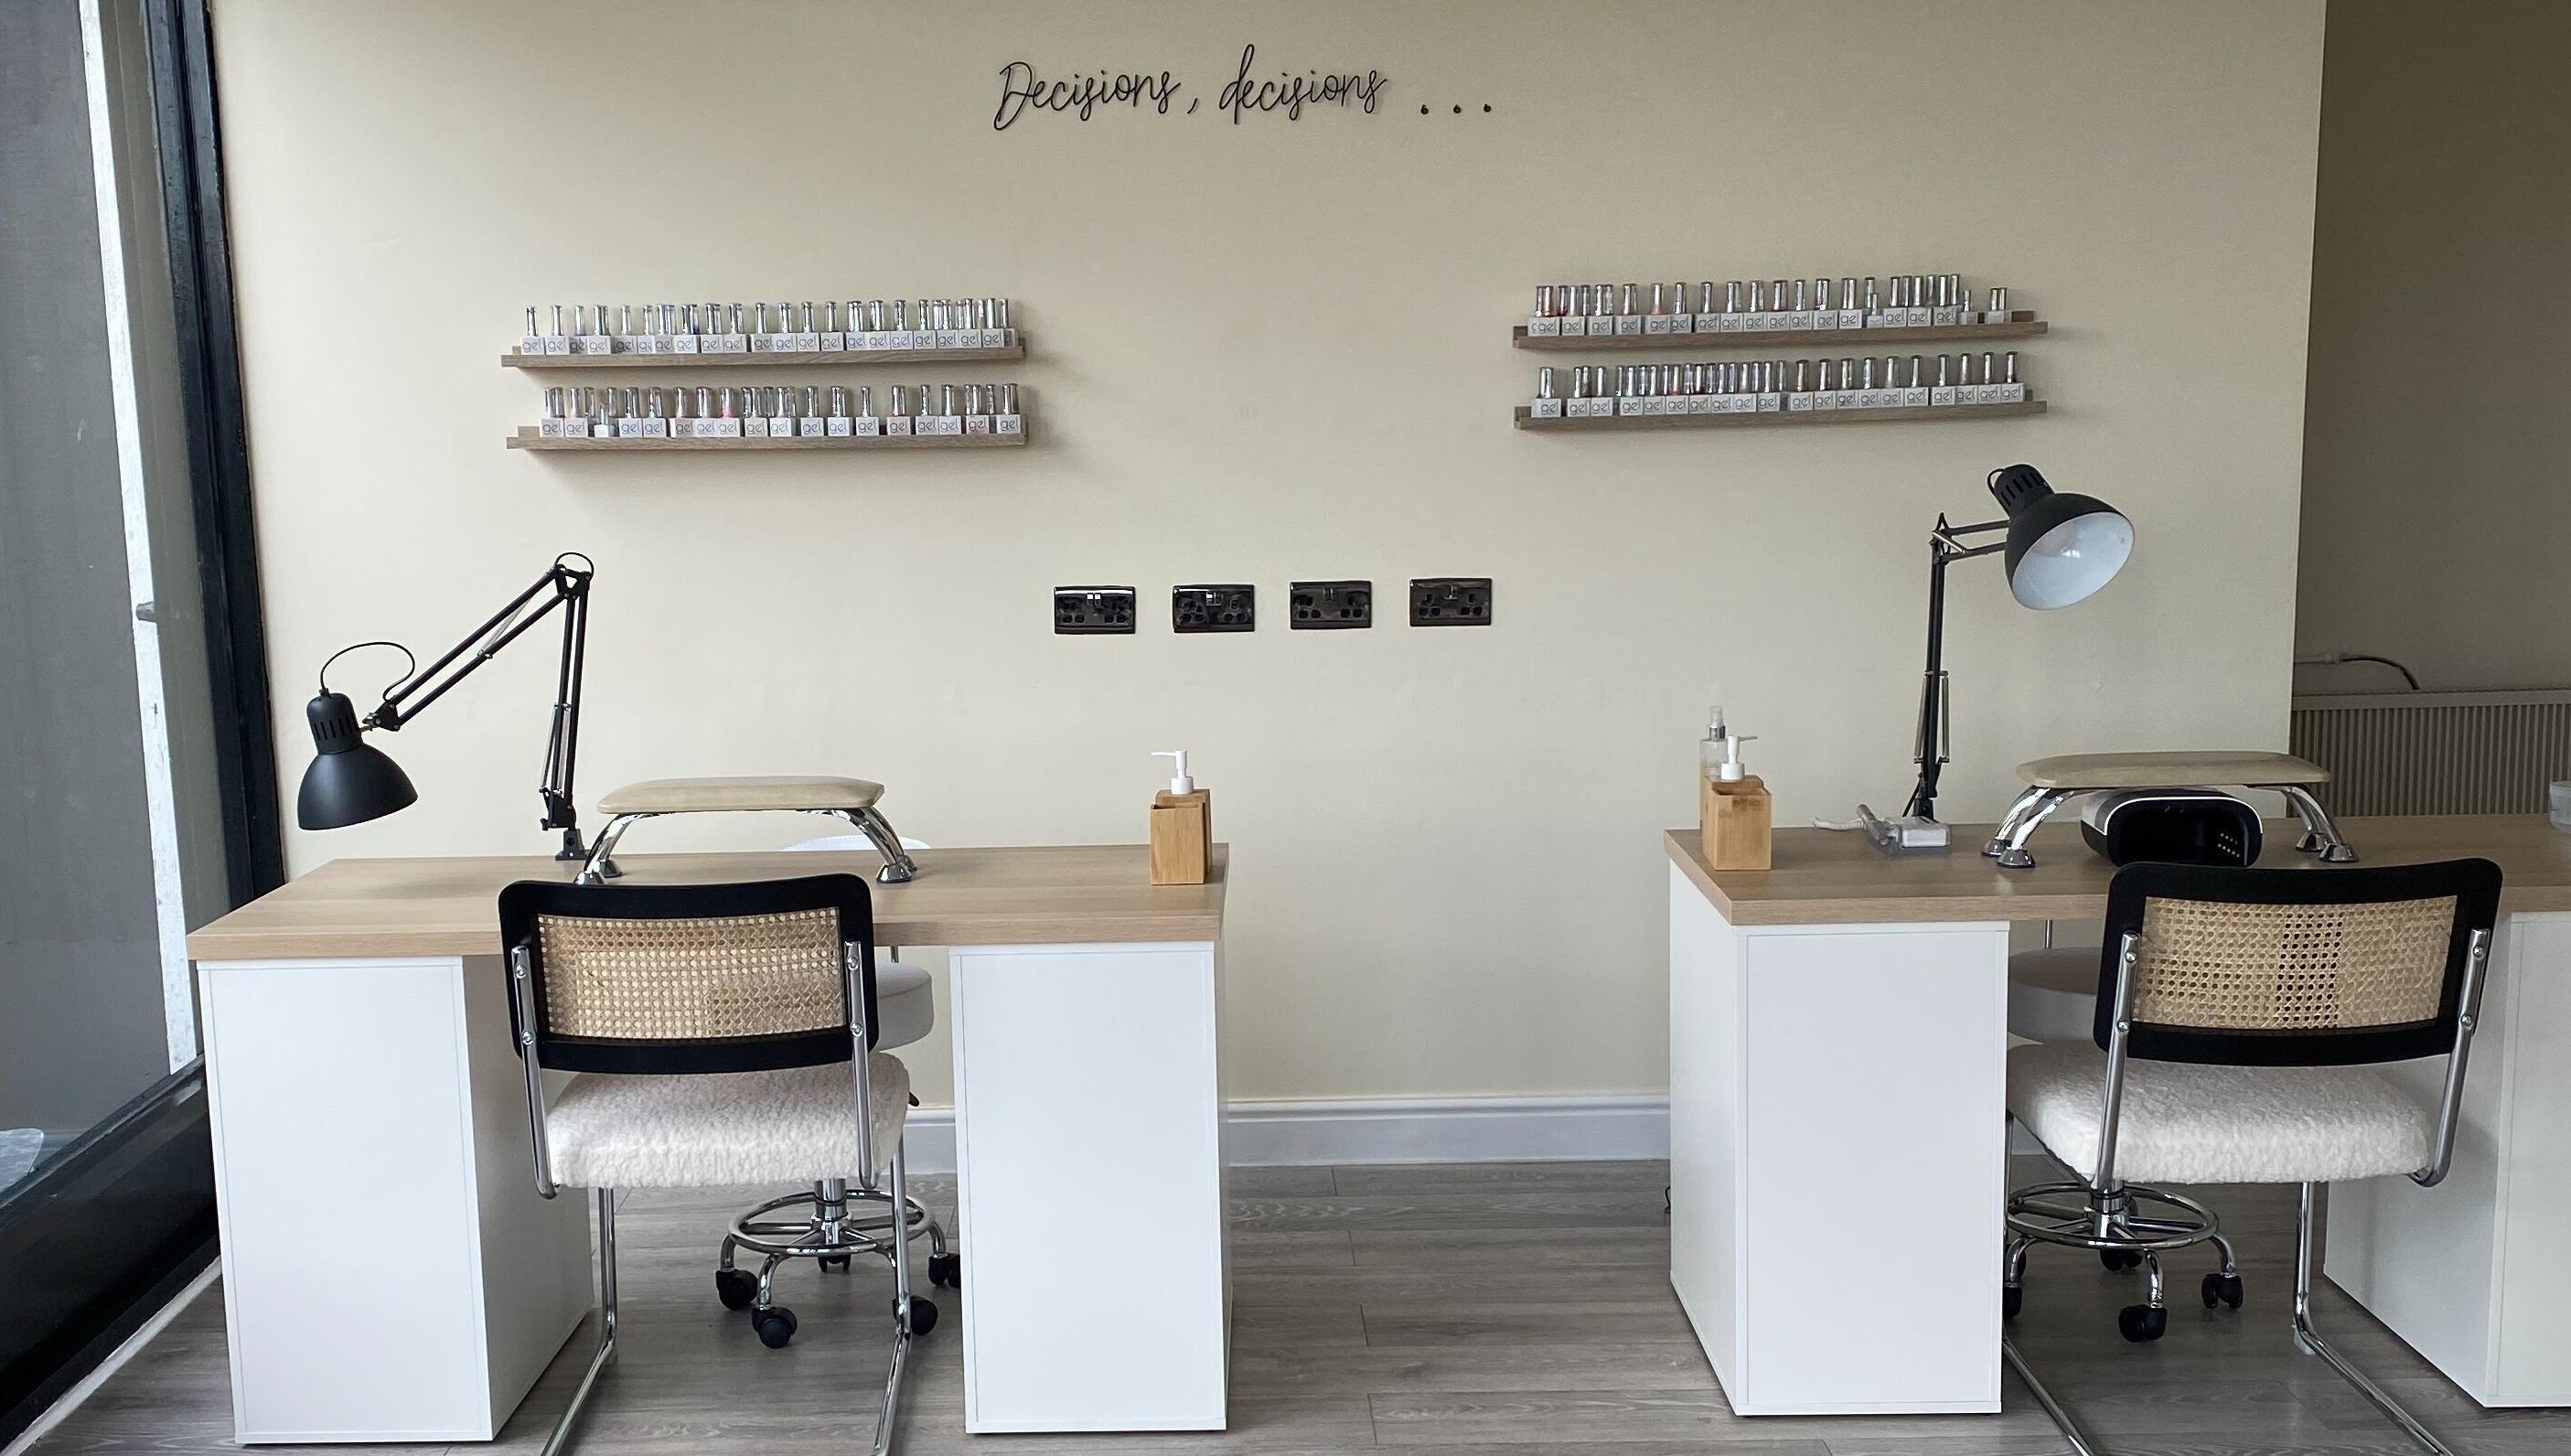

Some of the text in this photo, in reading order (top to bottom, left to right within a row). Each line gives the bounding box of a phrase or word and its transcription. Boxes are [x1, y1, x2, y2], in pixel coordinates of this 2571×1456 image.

[1218, 43, 1388, 125] decisions
[1745, 315, 1764, 329] gel
[1769, 313, 1788, 328] gel
[1793, 313, 1810, 327] gel
[1817, 313, 1835, 327] gel
[1840, 313, 1859, 326] gel
[1886, 308, 1905, 324] gel
[1910, 308, 1928, 324] gel
[1936, 307, 1955, 323] gel
[1538, 318, 1556, 334] gel
[1564, 318, 1581, 333] gel
[1591, 317, 1610, 333] gel
[1621, 317, 1638, 332] gel
[1650, 316, 1668, 332] gel
[1670, 316, 1688, 329] gel
[1698, 316, 1717, 330] gel
[1722, 316, 1741, 330] gel
[522, 337, 541, 353] gel
[548, 337, 566, 352] gel
[589, 337, 607, 352] gel
[616, 337, 636, 352] gel
[655, 337, 674, 351] gel
[677, 337, 693, 350] gel
[702, 337, 720, 351] gel
[724, 336, 744, 350] gel
[755, 336, 772, 350] gel
[776, 336, 795, 350] gel
[799, 335, 817, 349] gel
[821, 334, 840, 349] gel
[847, 334, 866, 348] gel
[869, 333, 888, 348] gel
[892, 333, 911, 347] gel
[916, 333, 933, 347] gel
[937, 332, 958, 346] gel
[960, 331, 980, 346] gel
[984, 330, 1002, 346] gel
[1816, 392, 1833, 407] gel
[1838, 392, 1856, 406] gel
[1860, 391, 1879, 405] gel
[1882, 391, 1901, 405] gel
[1907, 389, 1925, 403] gel
[1934, 388, 1953, 403] gel
[1955, 387, 1975, 401] gel
[1980, 387, 1998, 401] gel
[2001, 385, 2021, 400] gel
[1540, 400, 1559, 415] gel
[1569, 400, 1588, 415] gel
[1592, 399, 1610, 414] gel
[1623, 398, 1641, 413] gel
[1645, 398, 1664, 412] gel
[1668, 397, 1686, 412] gel
[1690, 397, 1709, 412] gel
[1712, 396, 1732, 412] gel
[1736, 395, 1754, 410] gel
[1759, 394, 1778, 409] gel
[1793, 393, 1812, 409] gel
[543, 421, 562, 434] gel
[567, 421, 585, 434] gel
[622, 421, 640, 434] gel
[644, 421, 664, 434] gel
[676, 420, 693, 434] gel
[697, 421, 715, 434] gel
[719, 420, 737, 434] gel
[746, 420, 766, 434] gel
[770, 421, 788, 434] gel
[803, 421, 822, 434] gel
[829, 420, 846, 434] gel
[858, 419, 876, 434] gel
[890, 419, 908, 433] gel
[917, 418, 937, 433] gel
[940, 418, 959, 432] gel
[969, 416, 988, 432] gel
[1001, 417, 1019, 431] gel
